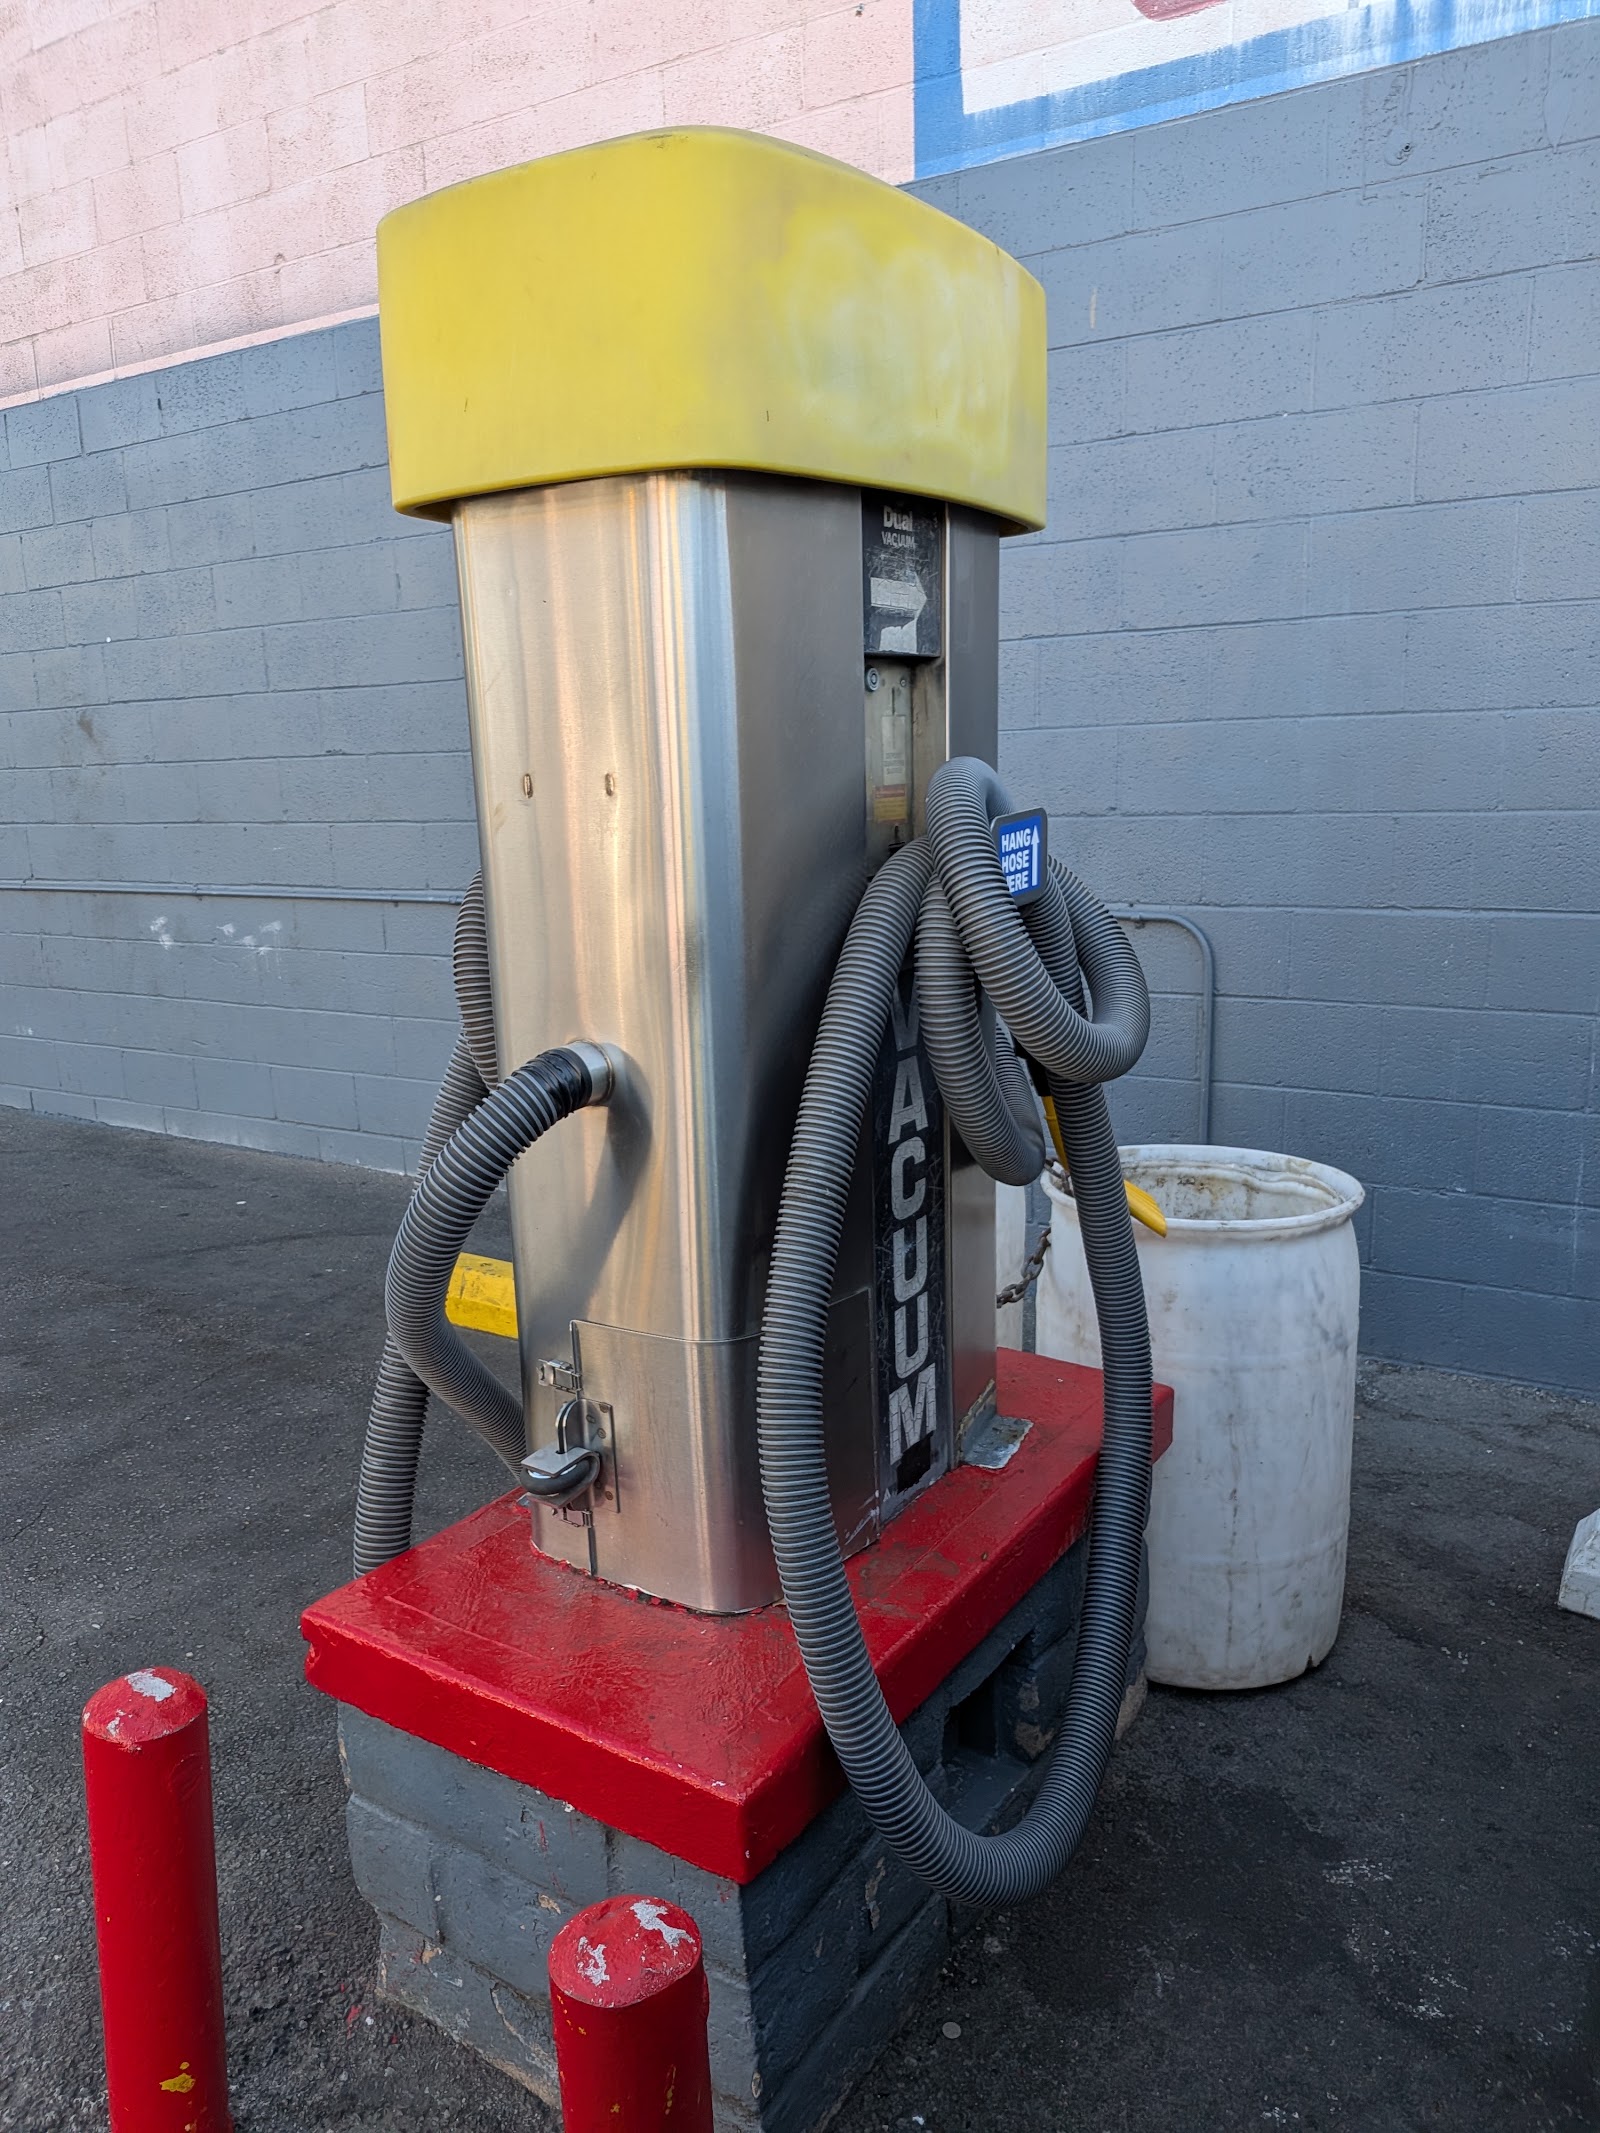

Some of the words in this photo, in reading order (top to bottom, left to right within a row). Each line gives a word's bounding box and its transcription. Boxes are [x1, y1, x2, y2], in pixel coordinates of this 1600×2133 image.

[883, 505, 913, 531] Dual
[881, 531, 917, 549] VACUUM
[1001, 828, 1031, 853] HANG
[1001, 849, 1030, 874] HOSE
[887, 970, 937, 1466] VACUUM
